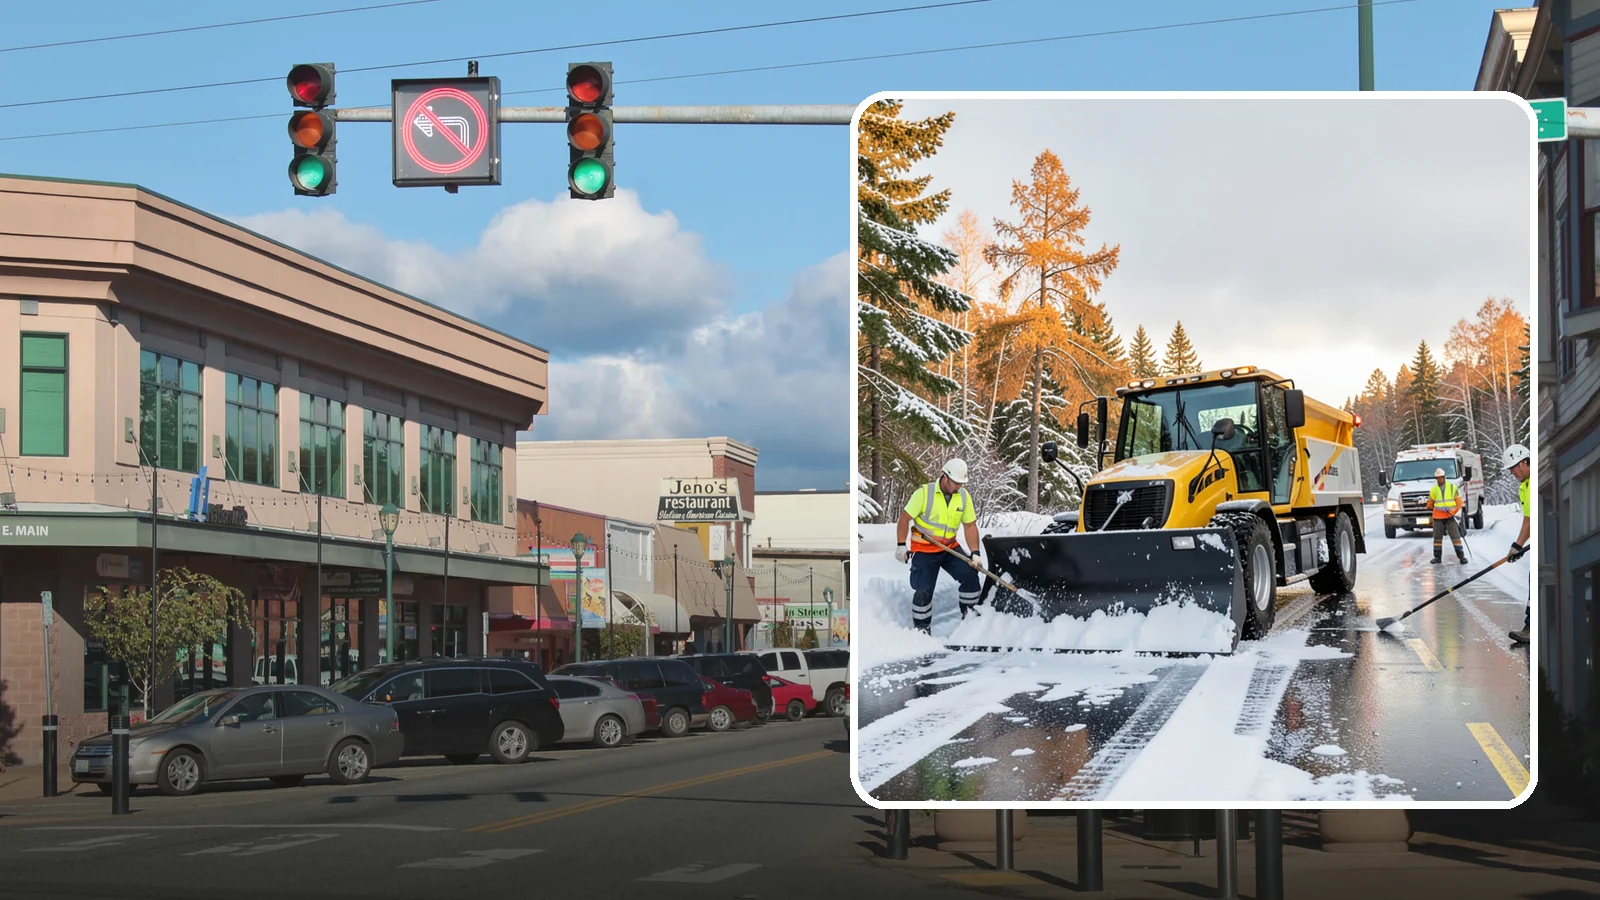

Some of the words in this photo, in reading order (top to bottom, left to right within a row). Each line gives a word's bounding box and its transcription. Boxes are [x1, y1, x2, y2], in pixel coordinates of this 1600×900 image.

[670, 480, 727, 494] Jeno's
[665, 496, 731, 509] restaurant
[659, 510, 681, 519] Italian
[686, 510, 715, 519] American
[715, 510, 737, 519] Cuisine
[2, 525, 13, 536] E.
[15, 525, 49, 536] MAIN
[785, 607, 795, 616] in
[797, 607, 828, 617] Street
